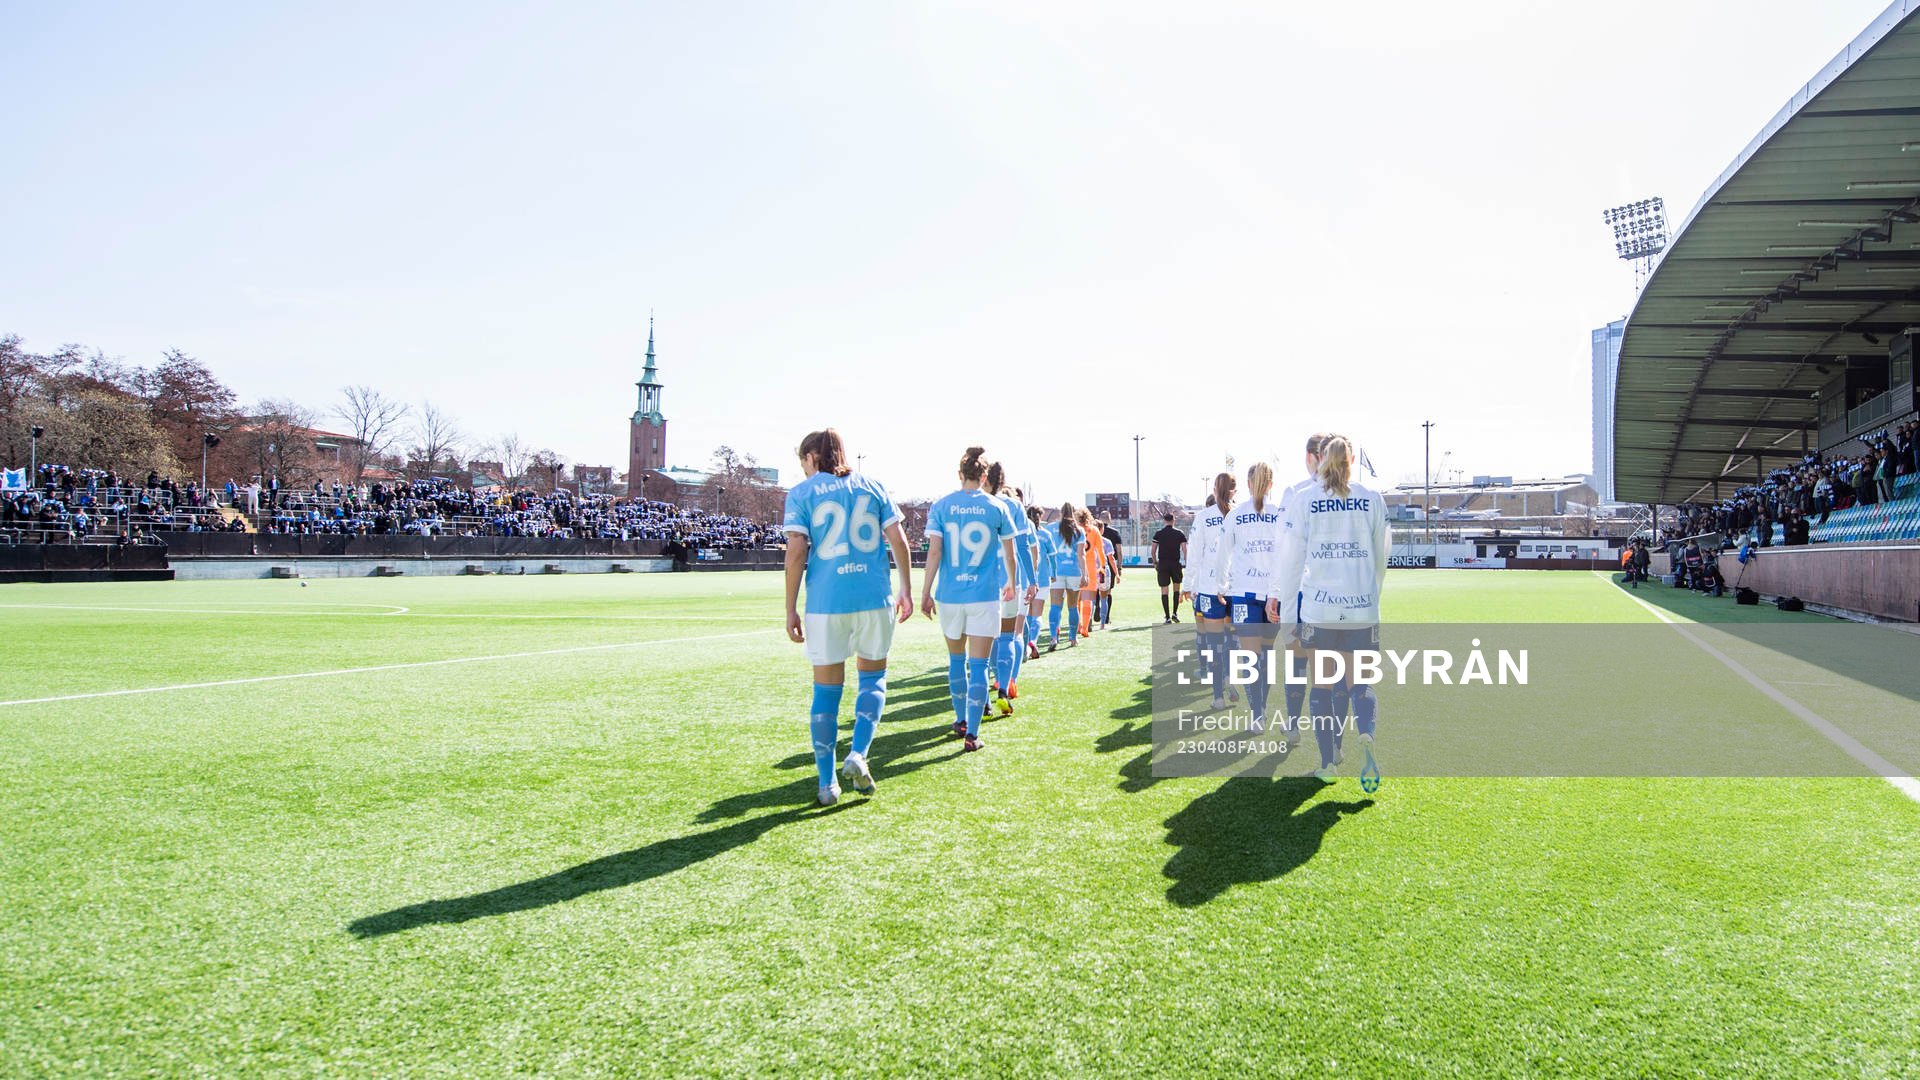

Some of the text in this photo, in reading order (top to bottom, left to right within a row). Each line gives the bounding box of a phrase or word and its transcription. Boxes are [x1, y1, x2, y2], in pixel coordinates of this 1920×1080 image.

[950, 505, 986, 515] Plantin
[1311, 498, 1370, 513] SERNEKE
[1236, 513, 1279, 525] SERNEK
[813, 495, 881, 560] 26
[945, 521, 992, 567] 19
[1321, 542, 1359, 550] NORDIC
[1311, 550, 1369, 559] WELLNESS
[1386, 556, 1426, 567] ERNEKE
